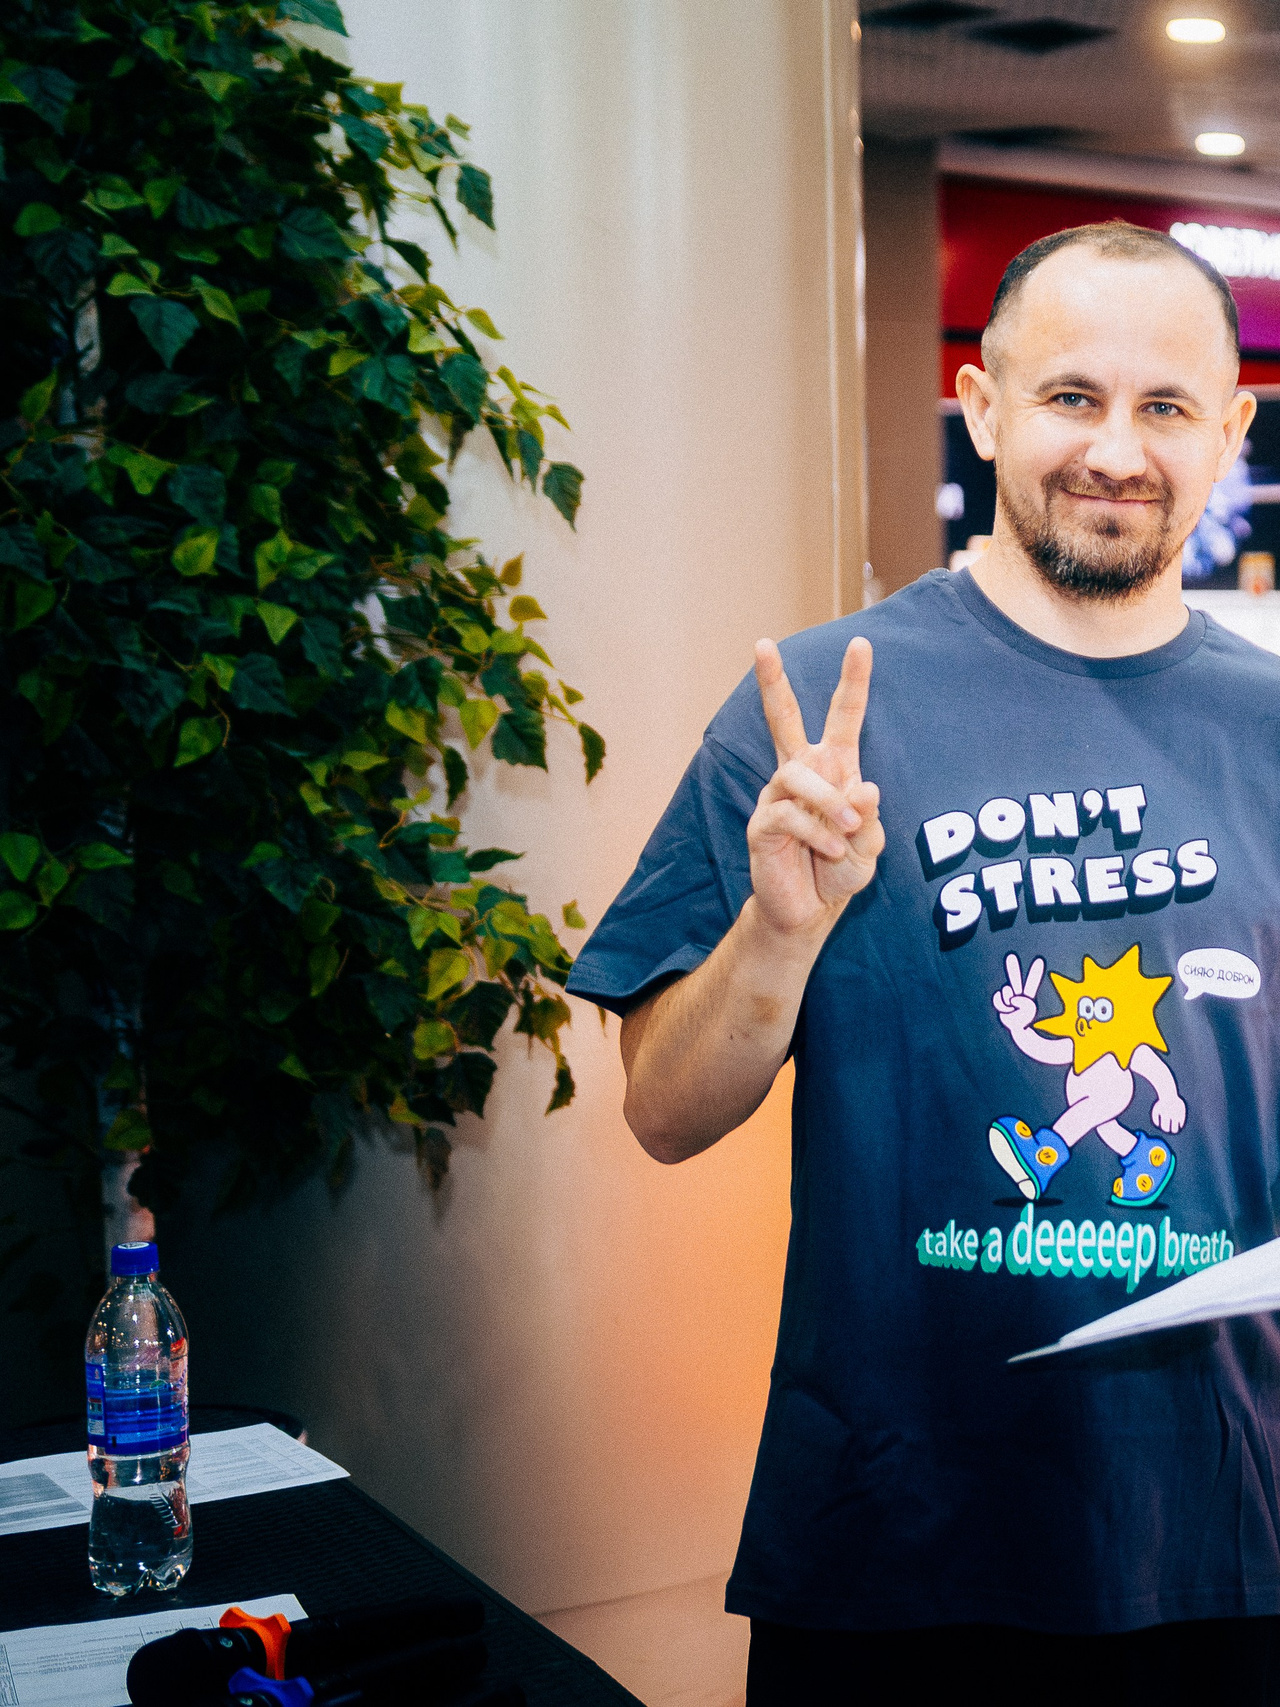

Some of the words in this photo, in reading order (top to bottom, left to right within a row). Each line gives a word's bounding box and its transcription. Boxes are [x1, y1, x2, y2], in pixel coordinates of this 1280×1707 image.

[919, 784, 1147, 872] DON'T
[935, 838, 1219, 943] STRESS
[1183, 964, 1215, 978] СИЯЮ
[1217, 969, 1255, 985] ДОБРОМ
[919, 1219, 979, 1265] take
[984, 1227, 1003, 1267] a
[1009, 1203, 1156, 1287] deeeeep
[1161, 1216, 1235, 1271] breath
